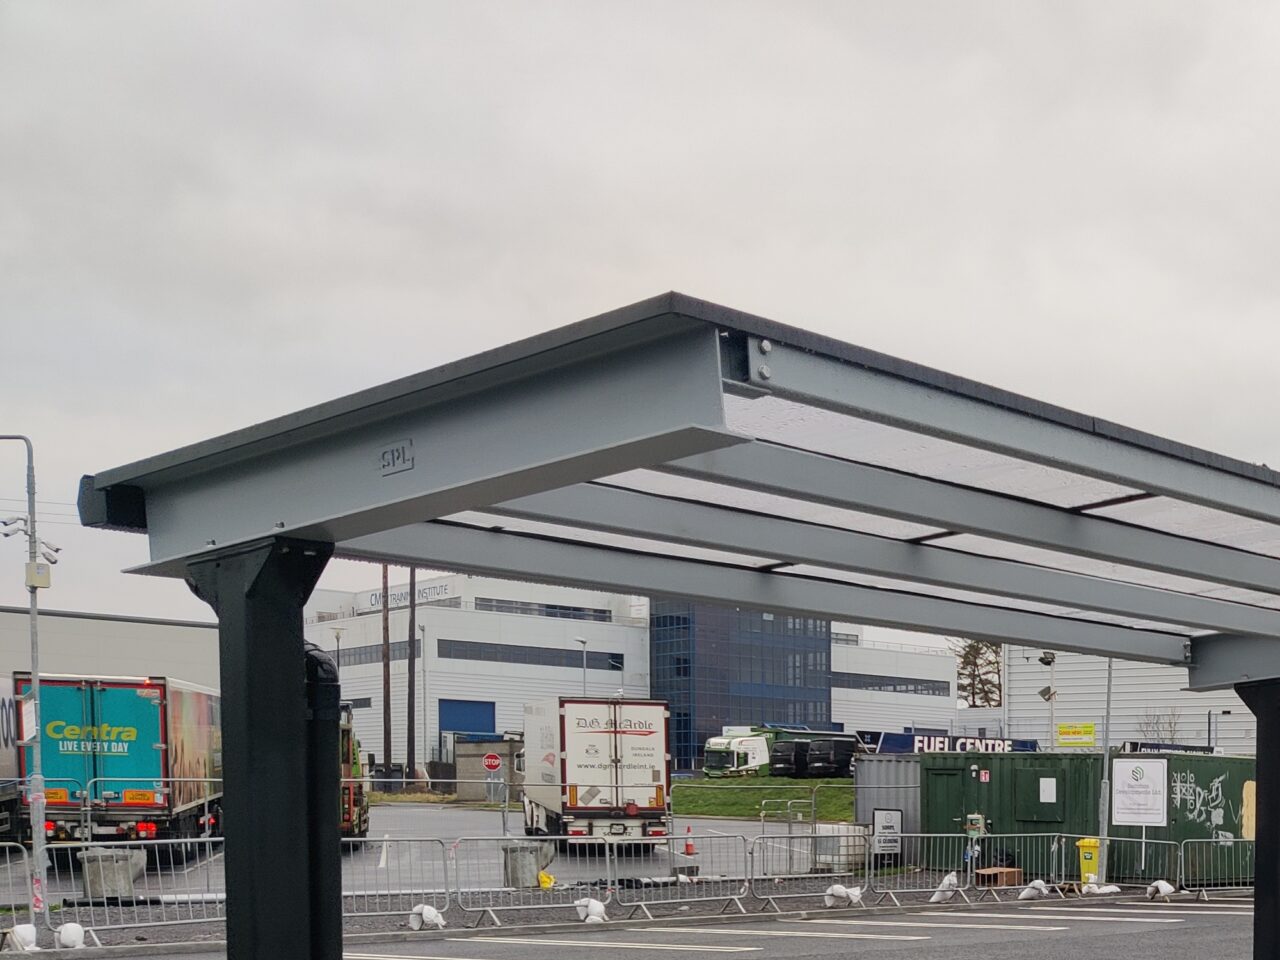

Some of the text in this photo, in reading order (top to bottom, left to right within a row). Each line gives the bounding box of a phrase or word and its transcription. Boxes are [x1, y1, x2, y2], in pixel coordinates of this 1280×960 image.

[417, 584, 449, 600] INSTITUTE
[45, 720, 138, 741] Centra
[59, 740, 129, 753] LIVE EVERY DAY
[914, 735, 1013, 753] FUEL CENTRE
[484, 758, 500, 766] STOP
